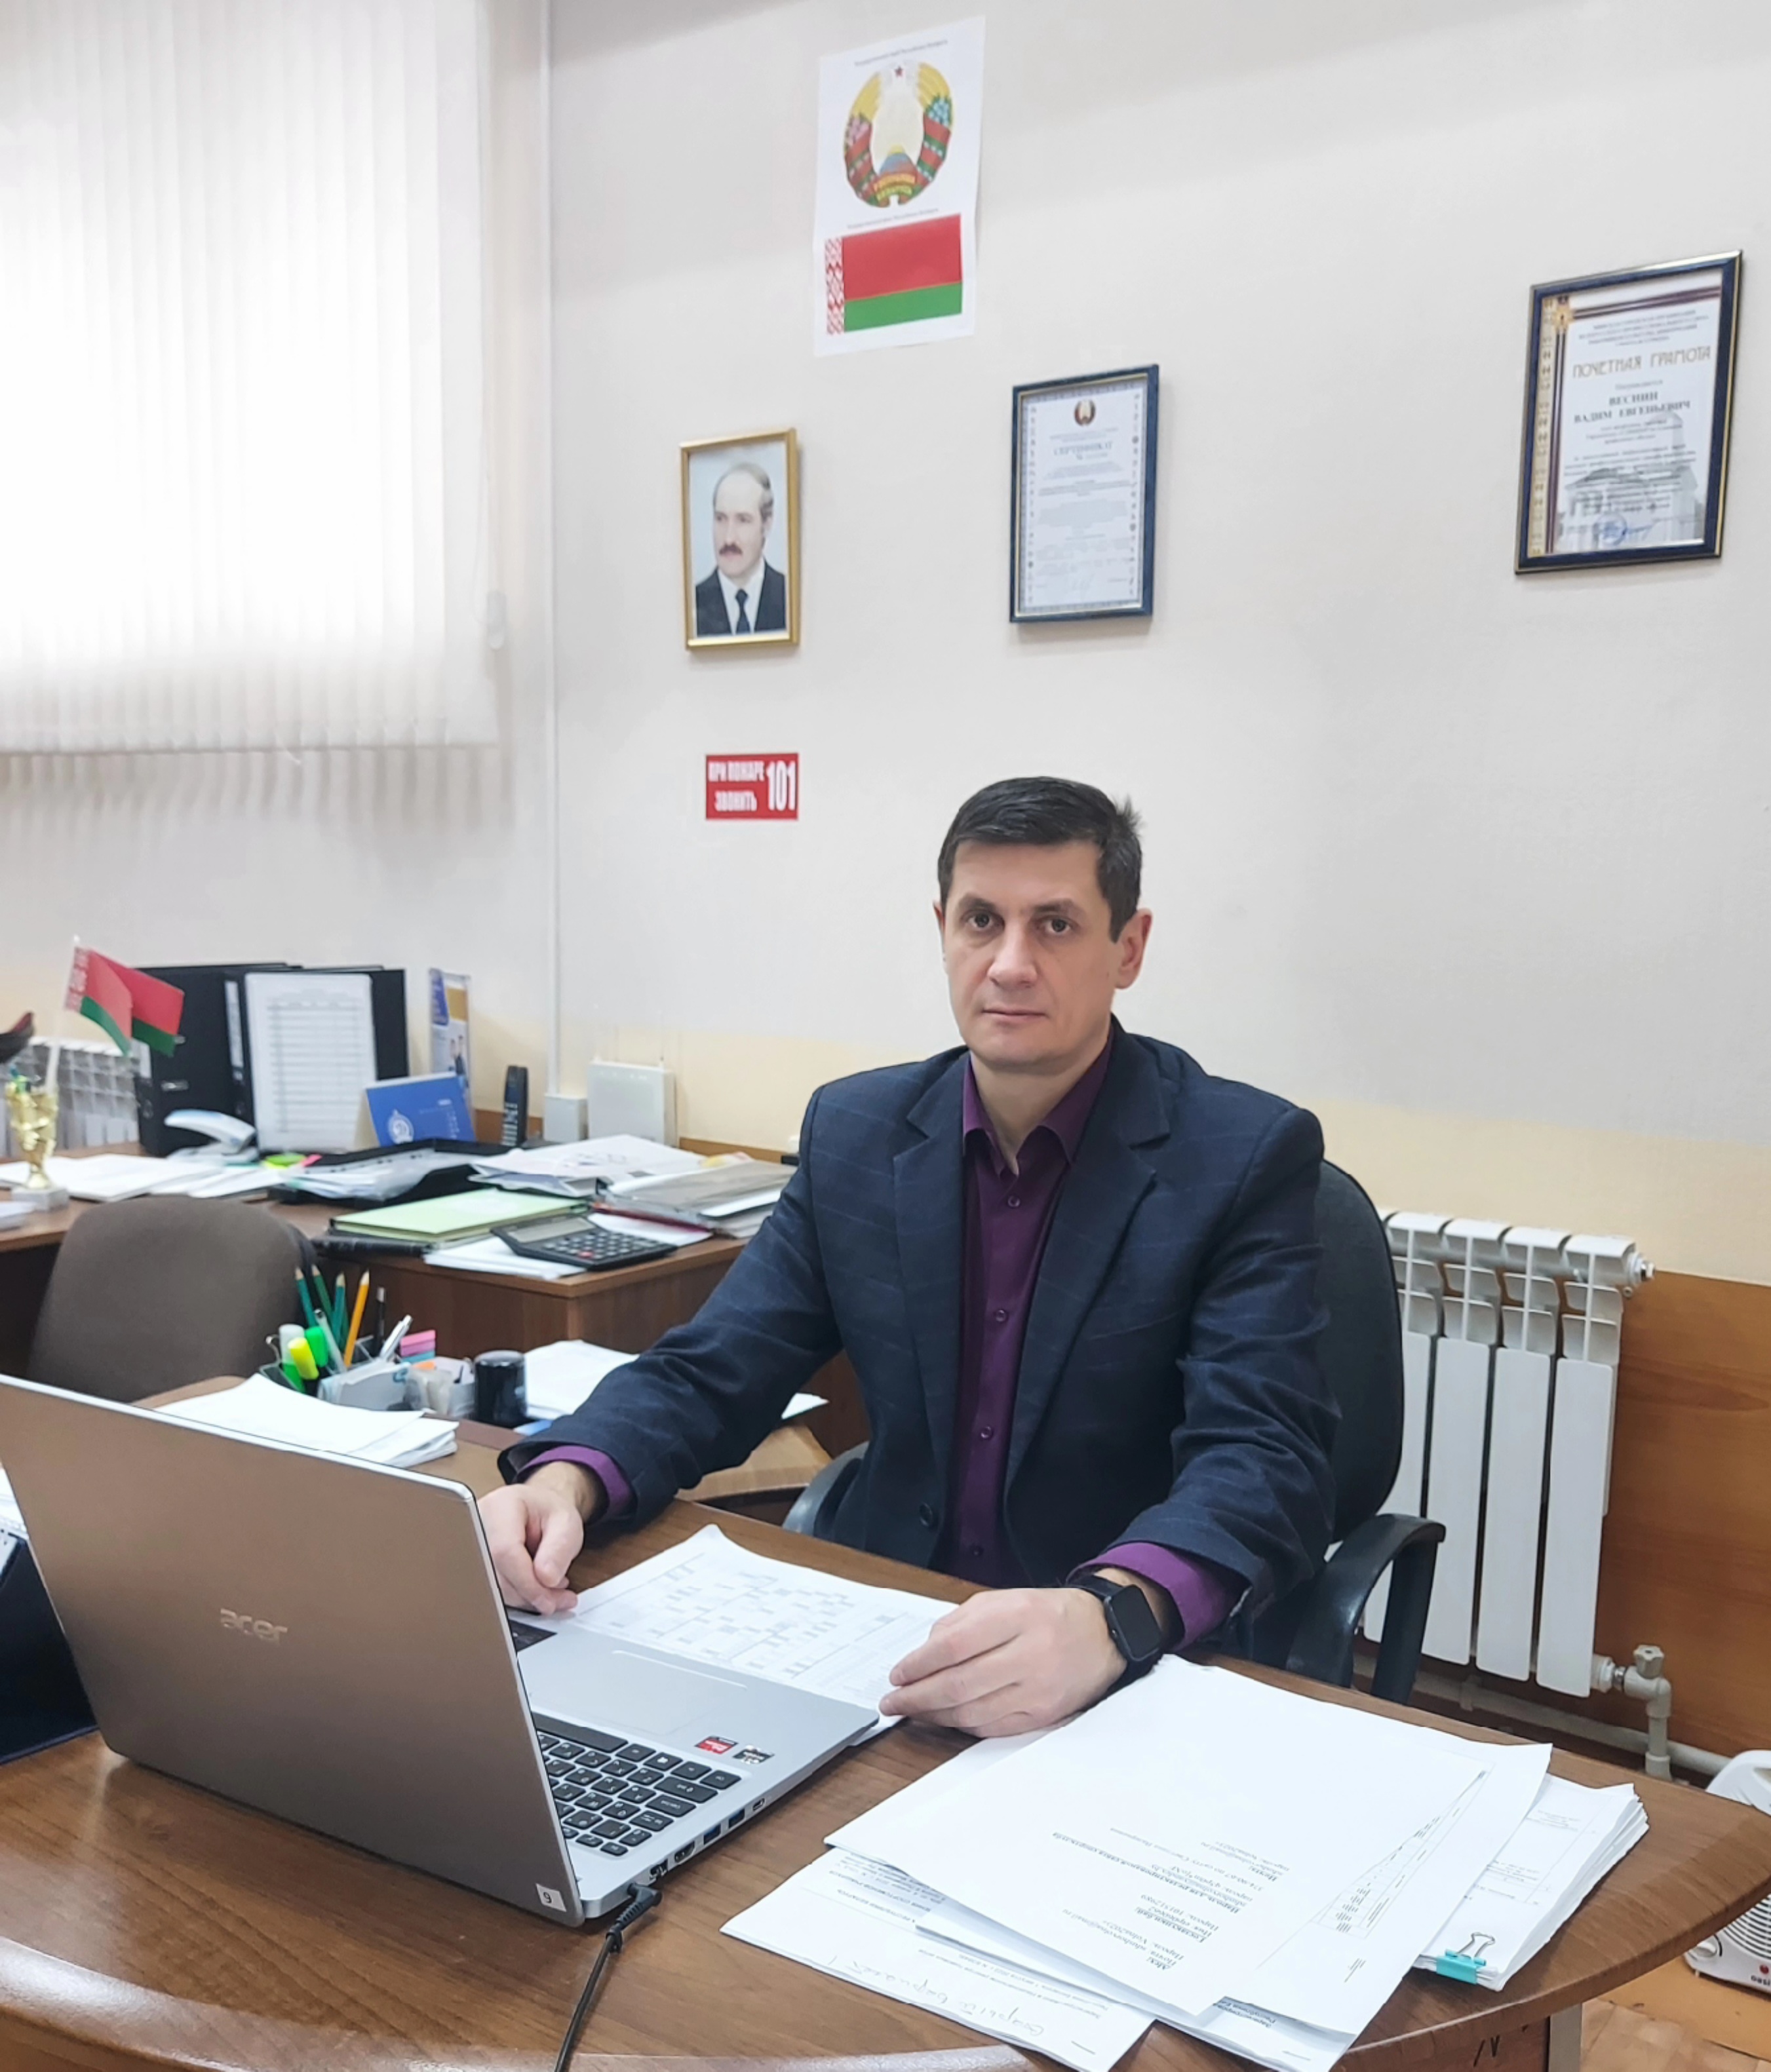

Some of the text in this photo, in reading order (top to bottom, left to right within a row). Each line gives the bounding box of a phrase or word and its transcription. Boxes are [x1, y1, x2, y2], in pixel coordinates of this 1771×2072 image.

[1573, 356, 1642, 378] ПОЧЕТНАЯ
[766, 760, 796, 811] 101
[220, 1607, 288, 1645] acer
[543, 1892, 551, 1903] 9
